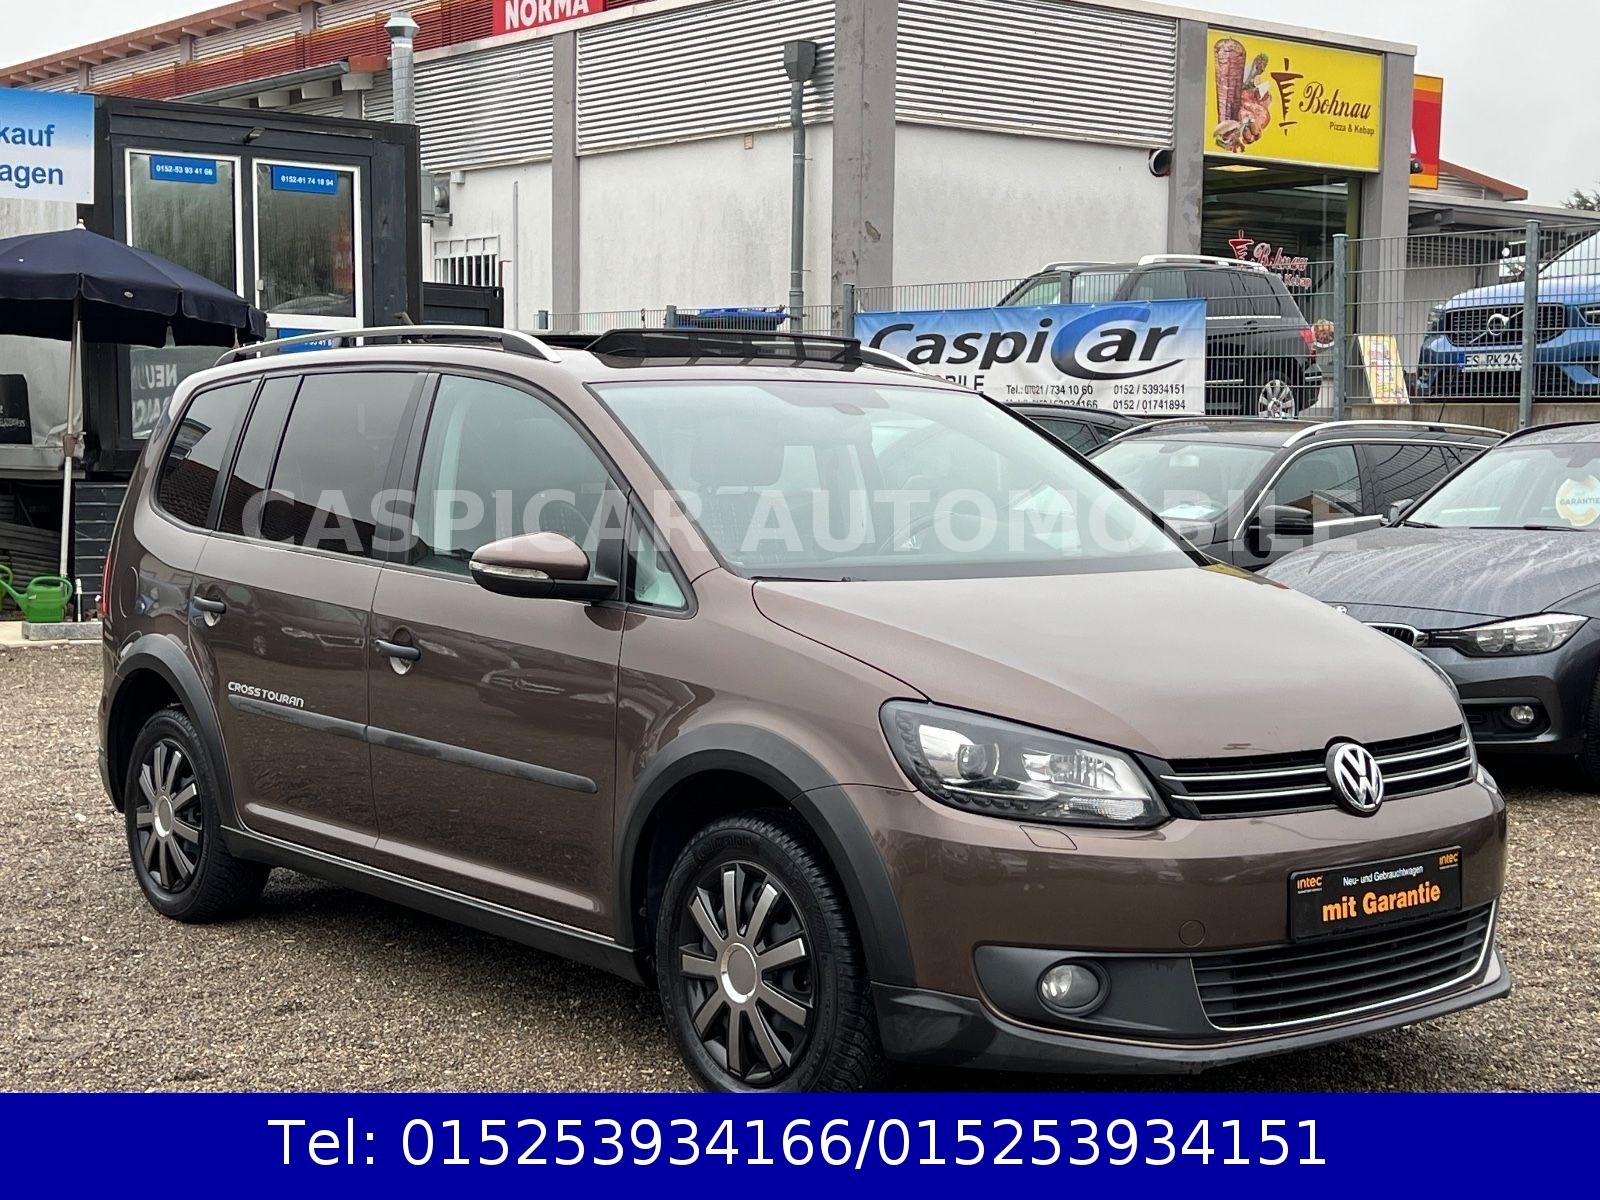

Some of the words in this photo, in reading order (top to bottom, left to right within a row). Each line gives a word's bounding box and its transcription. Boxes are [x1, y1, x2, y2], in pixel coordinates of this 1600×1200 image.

[505, 0, 590, 30] NORMA
[1299, 81, 1371, 119] Bohnau
[1329, 121, 1346, 132] Pizza
[1347, 124, 1353, 133] &
[1354, 125, 1375, 136] Kebap
[0, 164, 64, 189] agen
[1051, 384, 1065, 395] 734
[1068, 384, 1079, 395] 10
[1081, 384, 1093, 395] 60
[1113, 384, 1134, 395] 0152
[1142, 384, 1185, 395] 53934151
[1113, 399, 1134, 410] 0152
[1142, 399, 1186, 410] 01741894
[1343, 876, 1359, 887] Neu-
[1360, 871, 1372, 884] und
[1374, 865, 1424, 881] Gebrauchtwagen
[1322, 896, 1357, 922] mit
[1362, 881, 1441, 915] Garantie
